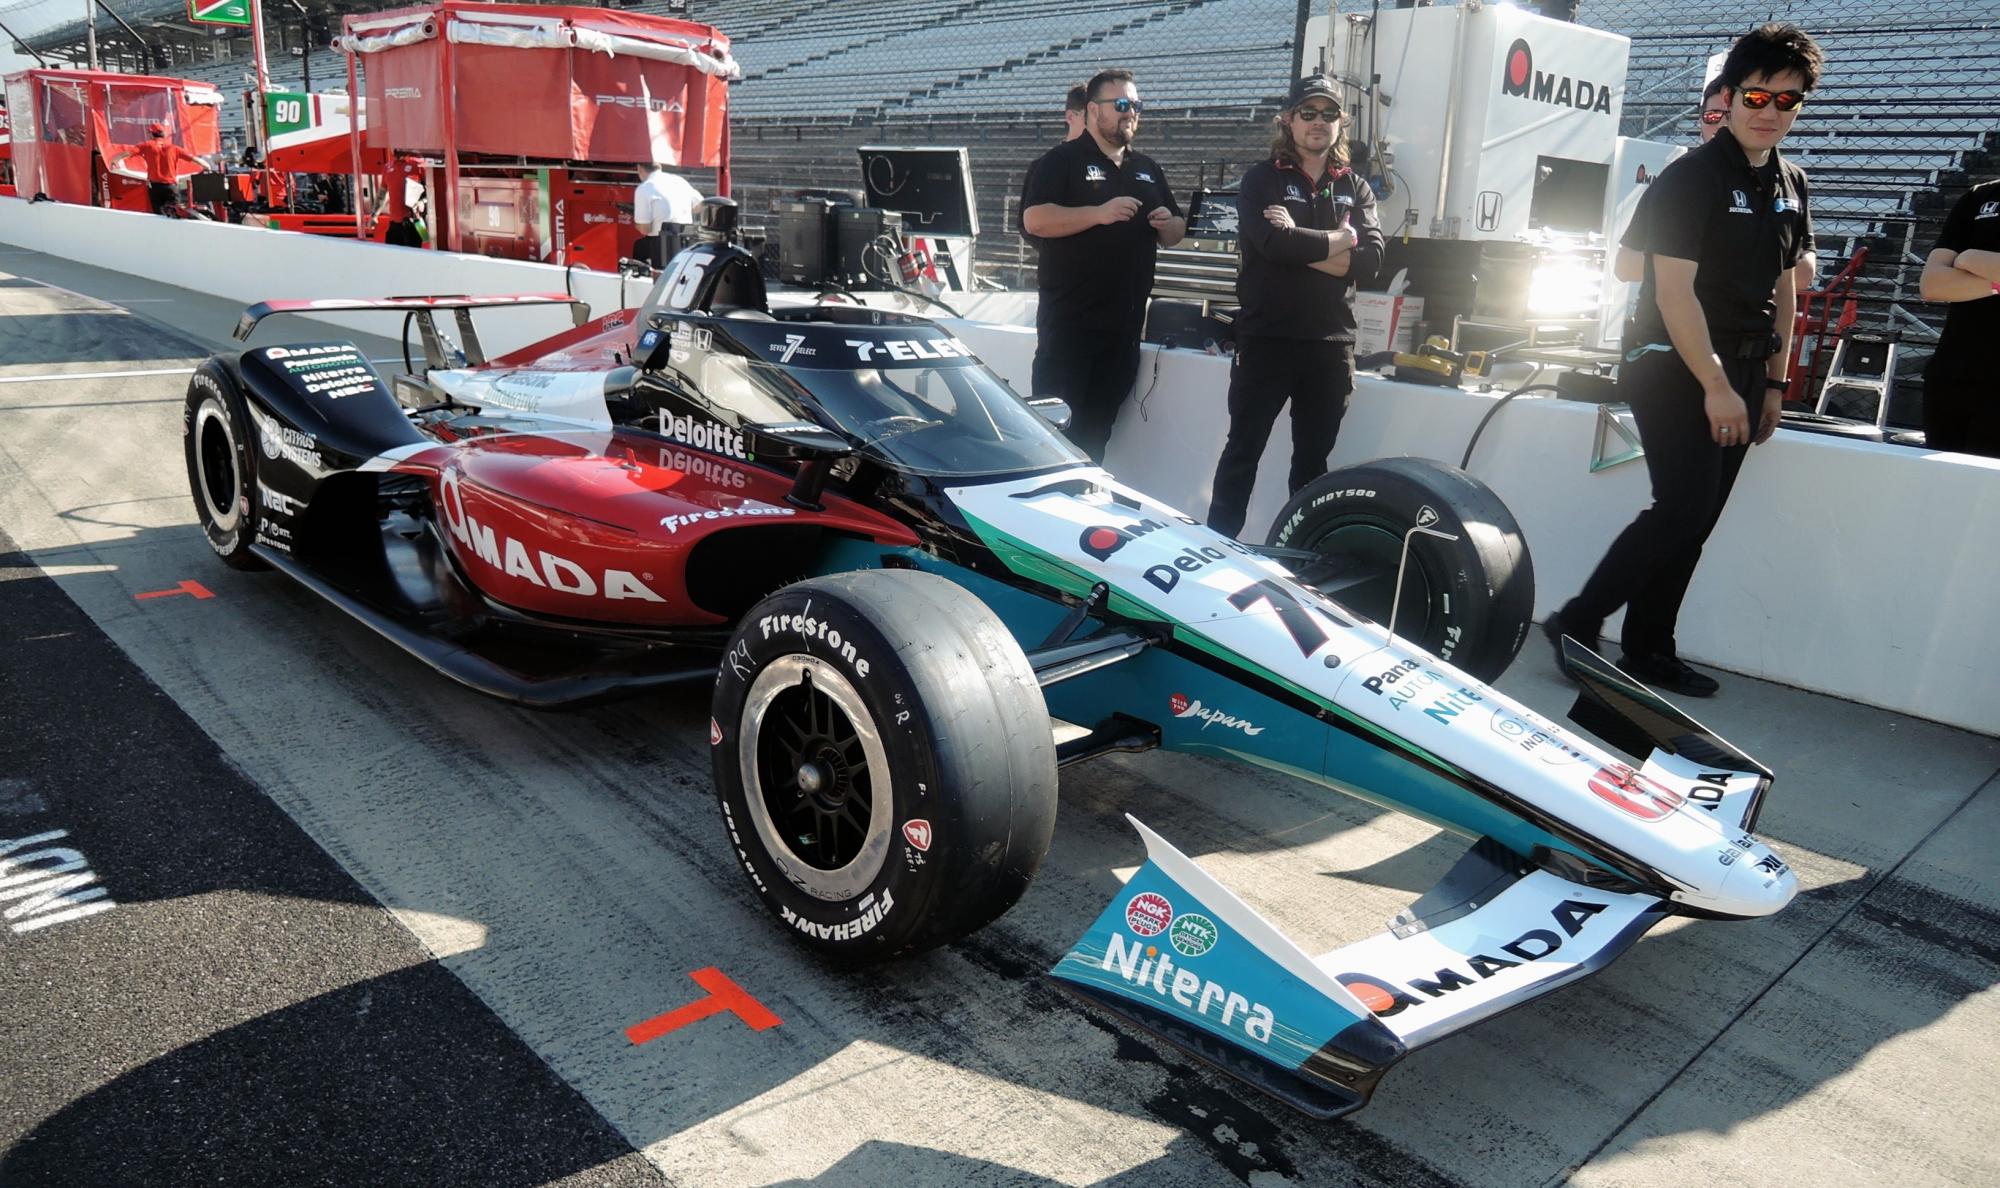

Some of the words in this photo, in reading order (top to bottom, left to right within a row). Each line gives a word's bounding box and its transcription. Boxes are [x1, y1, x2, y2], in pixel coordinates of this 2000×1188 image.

[1503, 38, 1611, 115] AMADA
[275, 101, 300, 123] 90
[596, 94, 685, 112] PREMA
[554, 198, 566, 266] REMA
[265, 345, 357, 360] AMADA
[769, 343, 786, 352] SEVEN
[796, 346, 817, 356] SELECT
[845, 338, 975, 361] 7-ELE
[301, 367, 367, 383] Niterra
[1312, 490, 1344, 508] INDY
[1345, 488, 1377, 498] 500
[660, 505, 796, 534] Firestone
[439, 467, 668, 603] AMADA
[1227, 579, 1331, 659] 7
[759, 613, 871, 679] Firestone
[1174, 699, 1267, 736] Japan
[1423, 687, 1483, 726] Nite
[743, 847, 768, 894] INDY
[810, 886, 852, 900] RACING
[779, 886, 895, 941] FIREHAWK
[1133, 911, 1160, 927] SPARK
[1136, 898, 1168, 919] NGK
[1130, 918, 1158, 934] PLUGS
[1181, 920, 1212, 940] NTK
[1335, 899, 1610, 1018] AMADA
[1101, 931, 1276, 1044] Niterra
